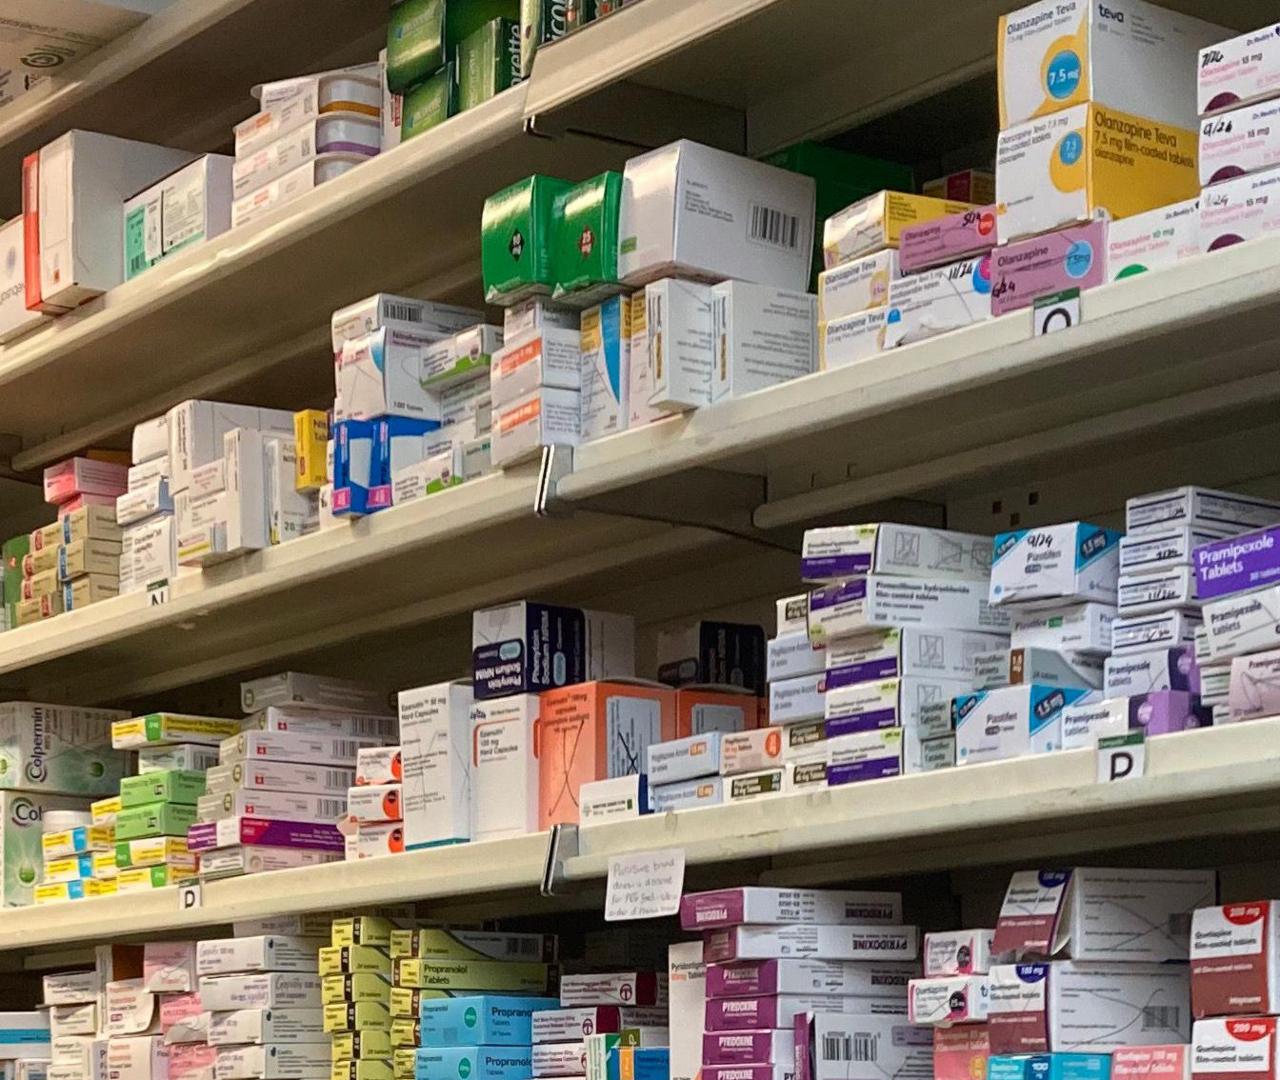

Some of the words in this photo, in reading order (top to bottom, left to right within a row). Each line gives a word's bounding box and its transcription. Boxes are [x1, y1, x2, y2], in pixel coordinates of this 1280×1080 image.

[1098, 3, 1124, 23] teva
[1094, 111, 1151, 141] Olanzapine
[1154, 132, 1177, 148] Teva
[998, 246, 1048, 267] Olanzapine
[1199, 535, 1274, 565] Pramipexole
[1200, 562, 1243, 582] Tablets
[24, 706, 49, 783] Colpermin
[423, 963, 468, 975] Propranolol
[423, 975, 450, 986] Tablets
